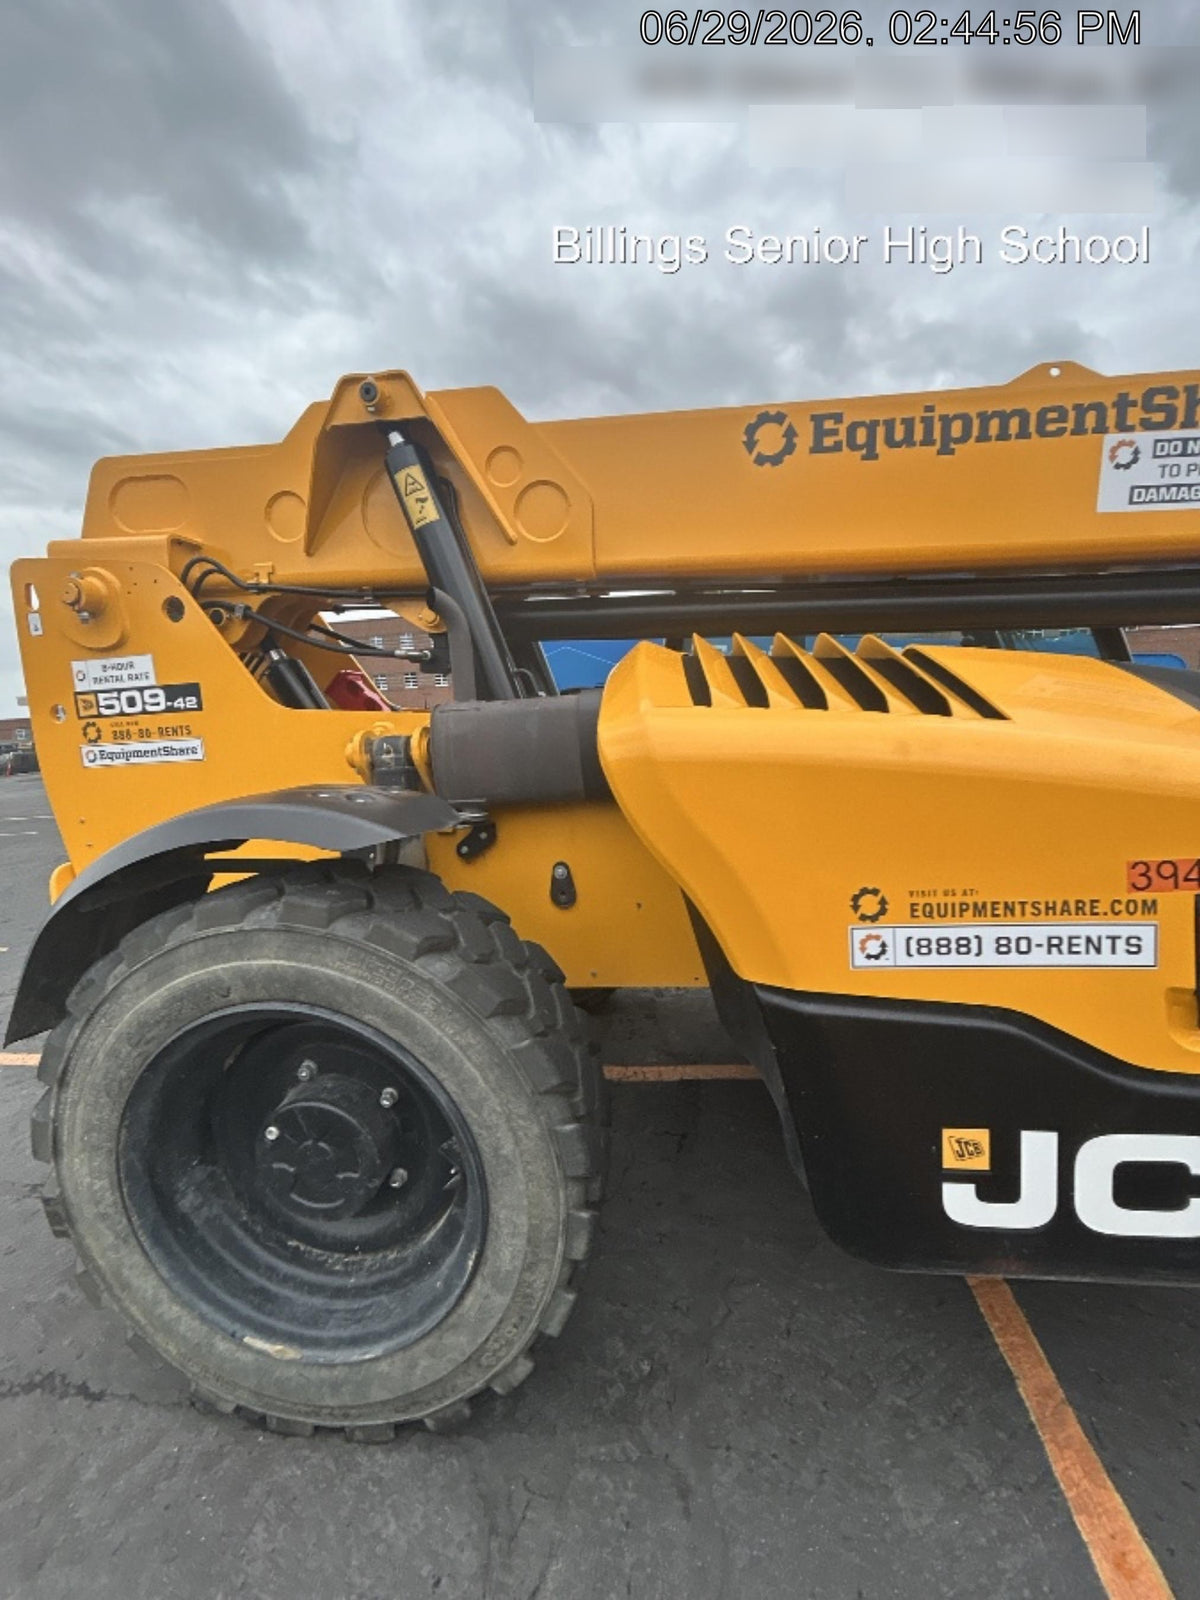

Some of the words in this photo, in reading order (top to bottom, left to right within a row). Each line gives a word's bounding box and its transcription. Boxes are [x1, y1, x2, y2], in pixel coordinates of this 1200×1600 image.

[1155, 440, 1182, 456] DO
[1158, 463, 1181, 479] TO
[1186, 462, 1200, 477] P
[1132, 485, 1200, 503] DAMAG
[92, 674, 125, 685] RENTAL
[127, 671, 150, 682] RATE
[97, 688, 198, 715] 509-42
[99, 745, 198, 761] EquipmentShare
[908, 890, 938, 898] VISIT
[943, 889, 957, 897] US
[909, 899, 1158, 919] EQUIPMENTSHARE.COM
[905, 935, 982, 957] (888)
[995, 935, 1143, 956] 80-RENTS
[955, 1139, 984, 1159] JCB
